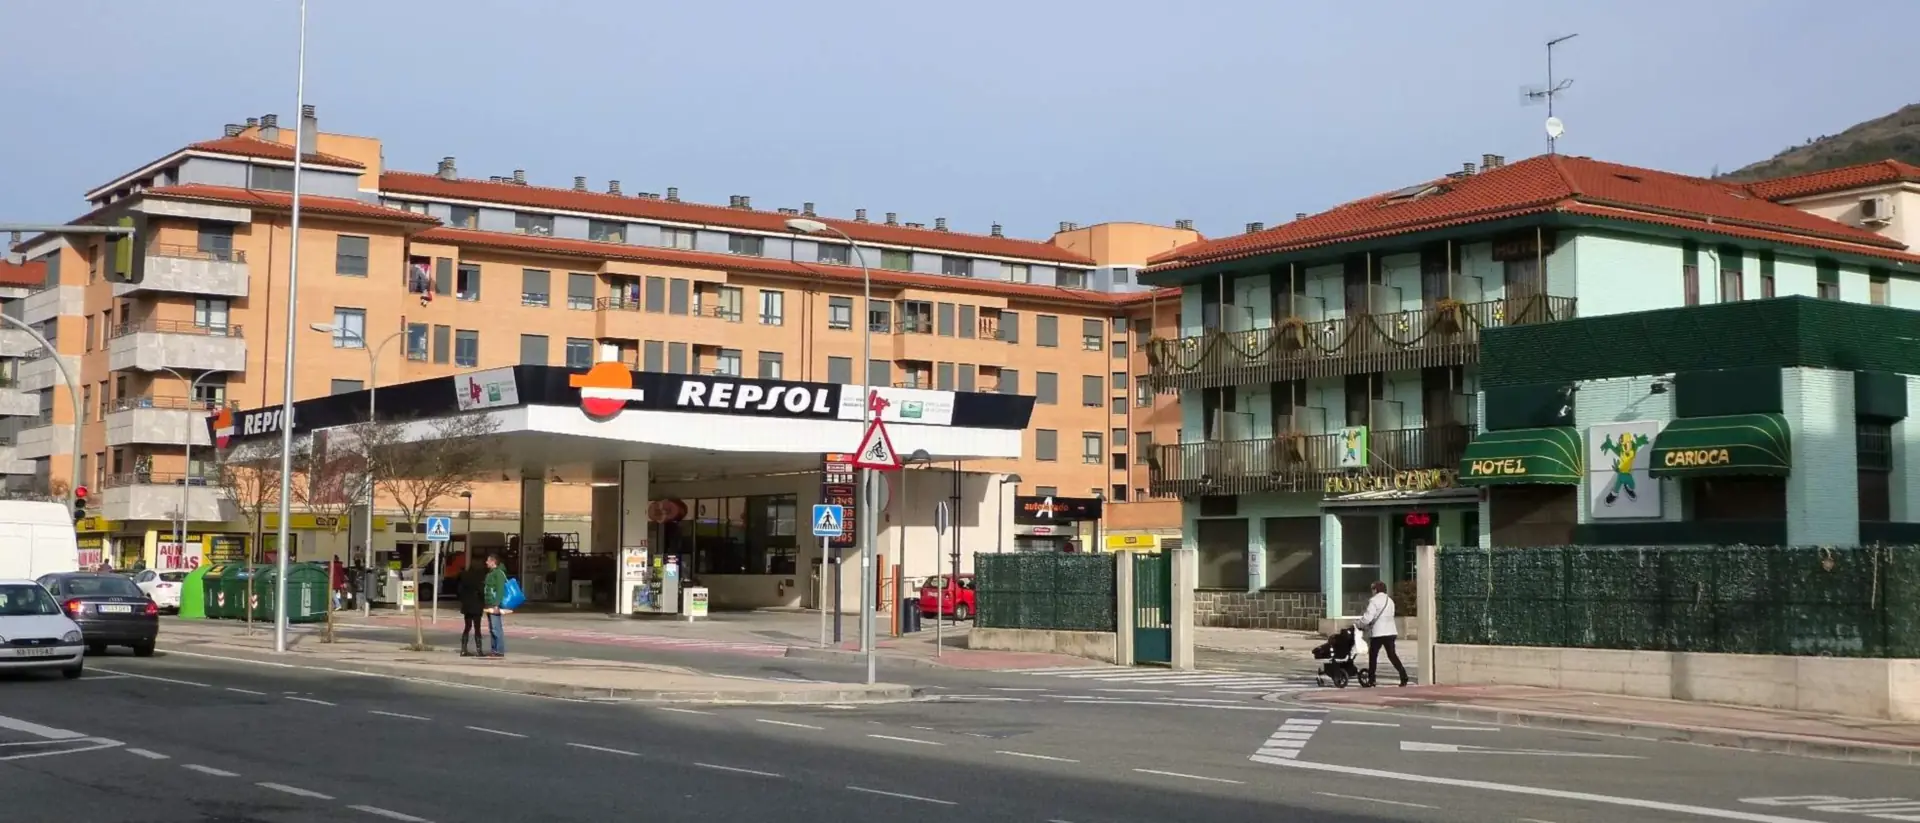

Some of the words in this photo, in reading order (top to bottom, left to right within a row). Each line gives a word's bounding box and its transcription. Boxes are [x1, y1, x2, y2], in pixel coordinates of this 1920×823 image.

[676, 380, 832, 414] REPSOL
[1665, 449, 1730, 467] CARIOCA
[1471, 459, 1526, 475] HOTEL
[1406, 513, 1429, 525] Club
